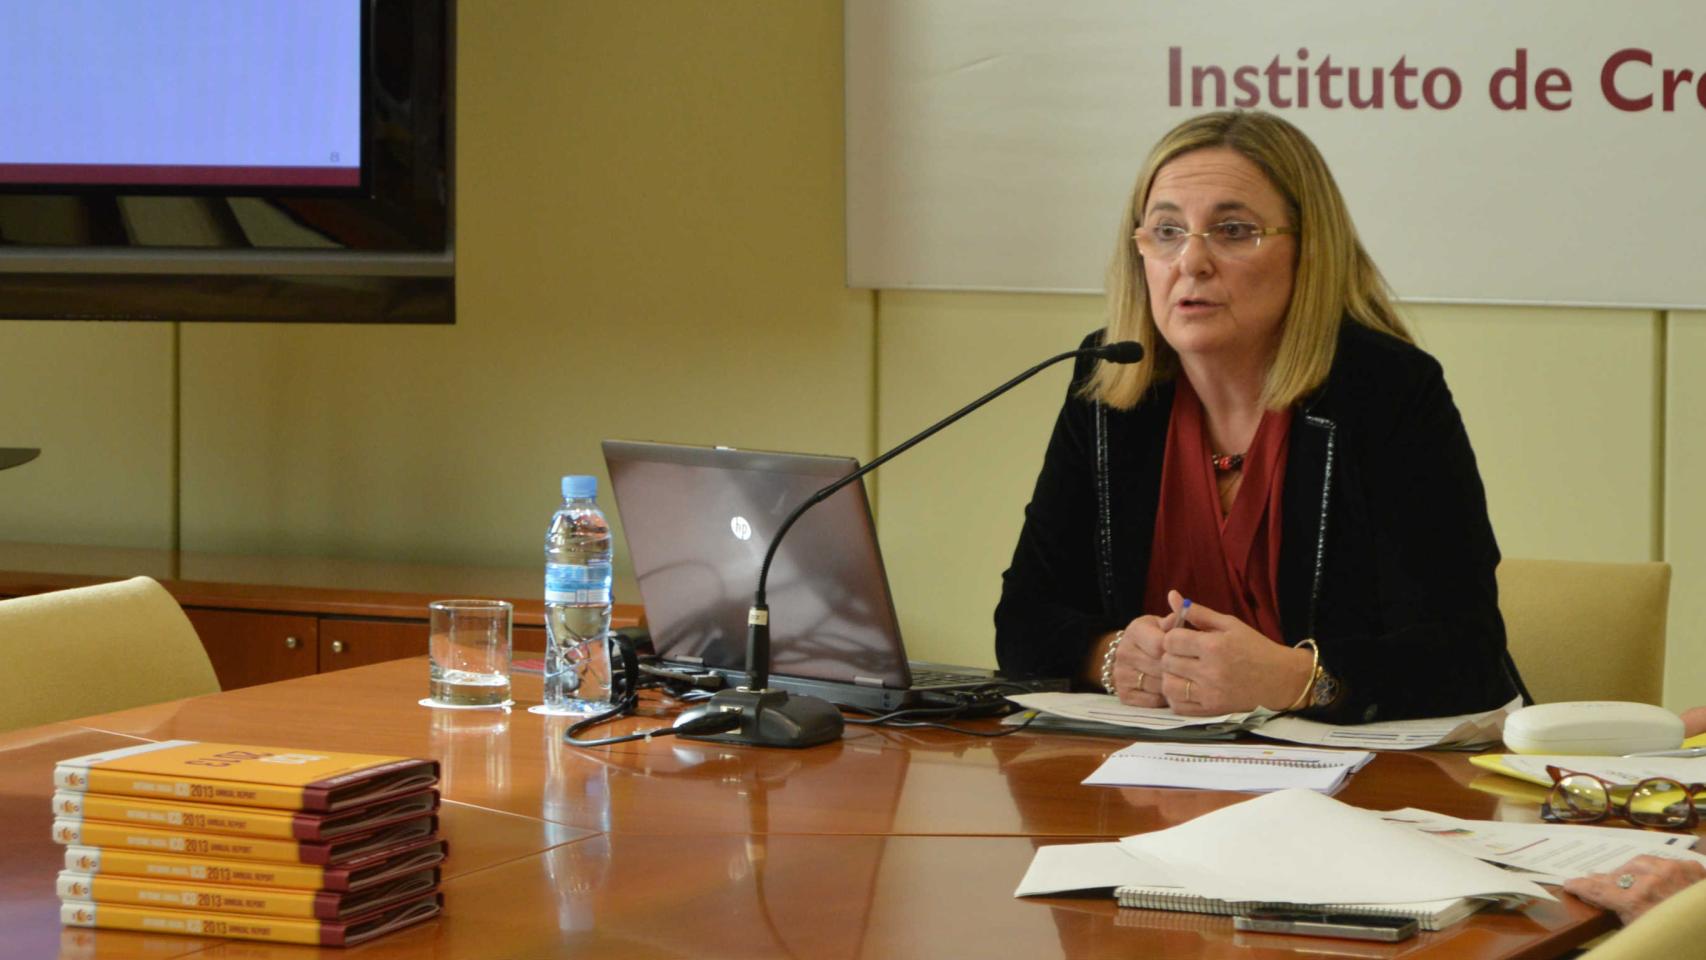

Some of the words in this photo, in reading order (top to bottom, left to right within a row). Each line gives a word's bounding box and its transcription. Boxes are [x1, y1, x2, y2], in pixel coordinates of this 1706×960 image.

[1168, 46, 1463, 111] Instituto
[1489, 48, 1573, 112] de
[1600, 47, 1706, 112] Cr
[191, 784, 214, 798] 2013
[183, 813, 205, 828] 2013
[185, 839, 208, 853] 2013
[207, 867, 231, 881] 2013
[198, 894, 222, 908] 2013
[203, 921, 227, 934] 2013
